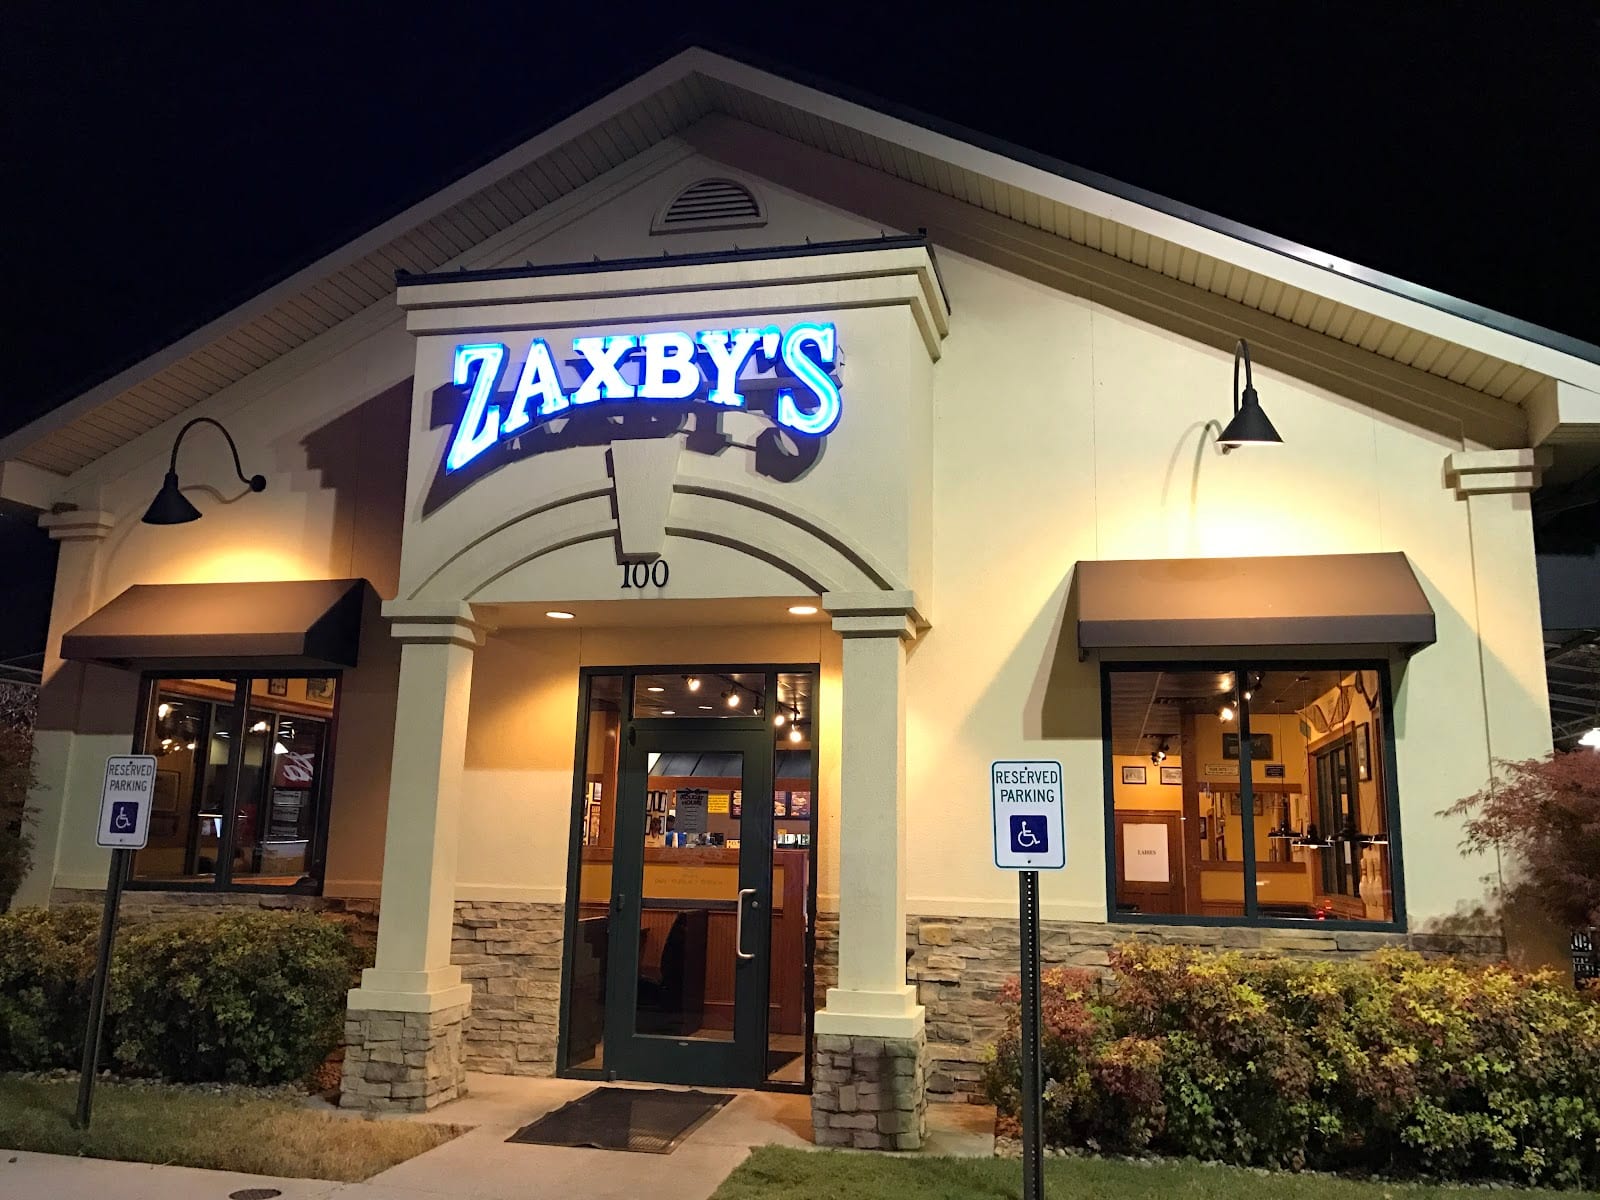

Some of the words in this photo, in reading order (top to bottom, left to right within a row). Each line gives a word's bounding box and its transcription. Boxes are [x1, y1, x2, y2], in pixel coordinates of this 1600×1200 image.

[445, 322, 842, 475] ZAXBY'S
[621, 560, 669, 589] 100
[109, 764, 152, 776] RESERVED
[995, 770, 1058, 784] RESERVED
[110, 779, 147, 792] PARKING
[1000, 789, 1055, 803] PARKING
